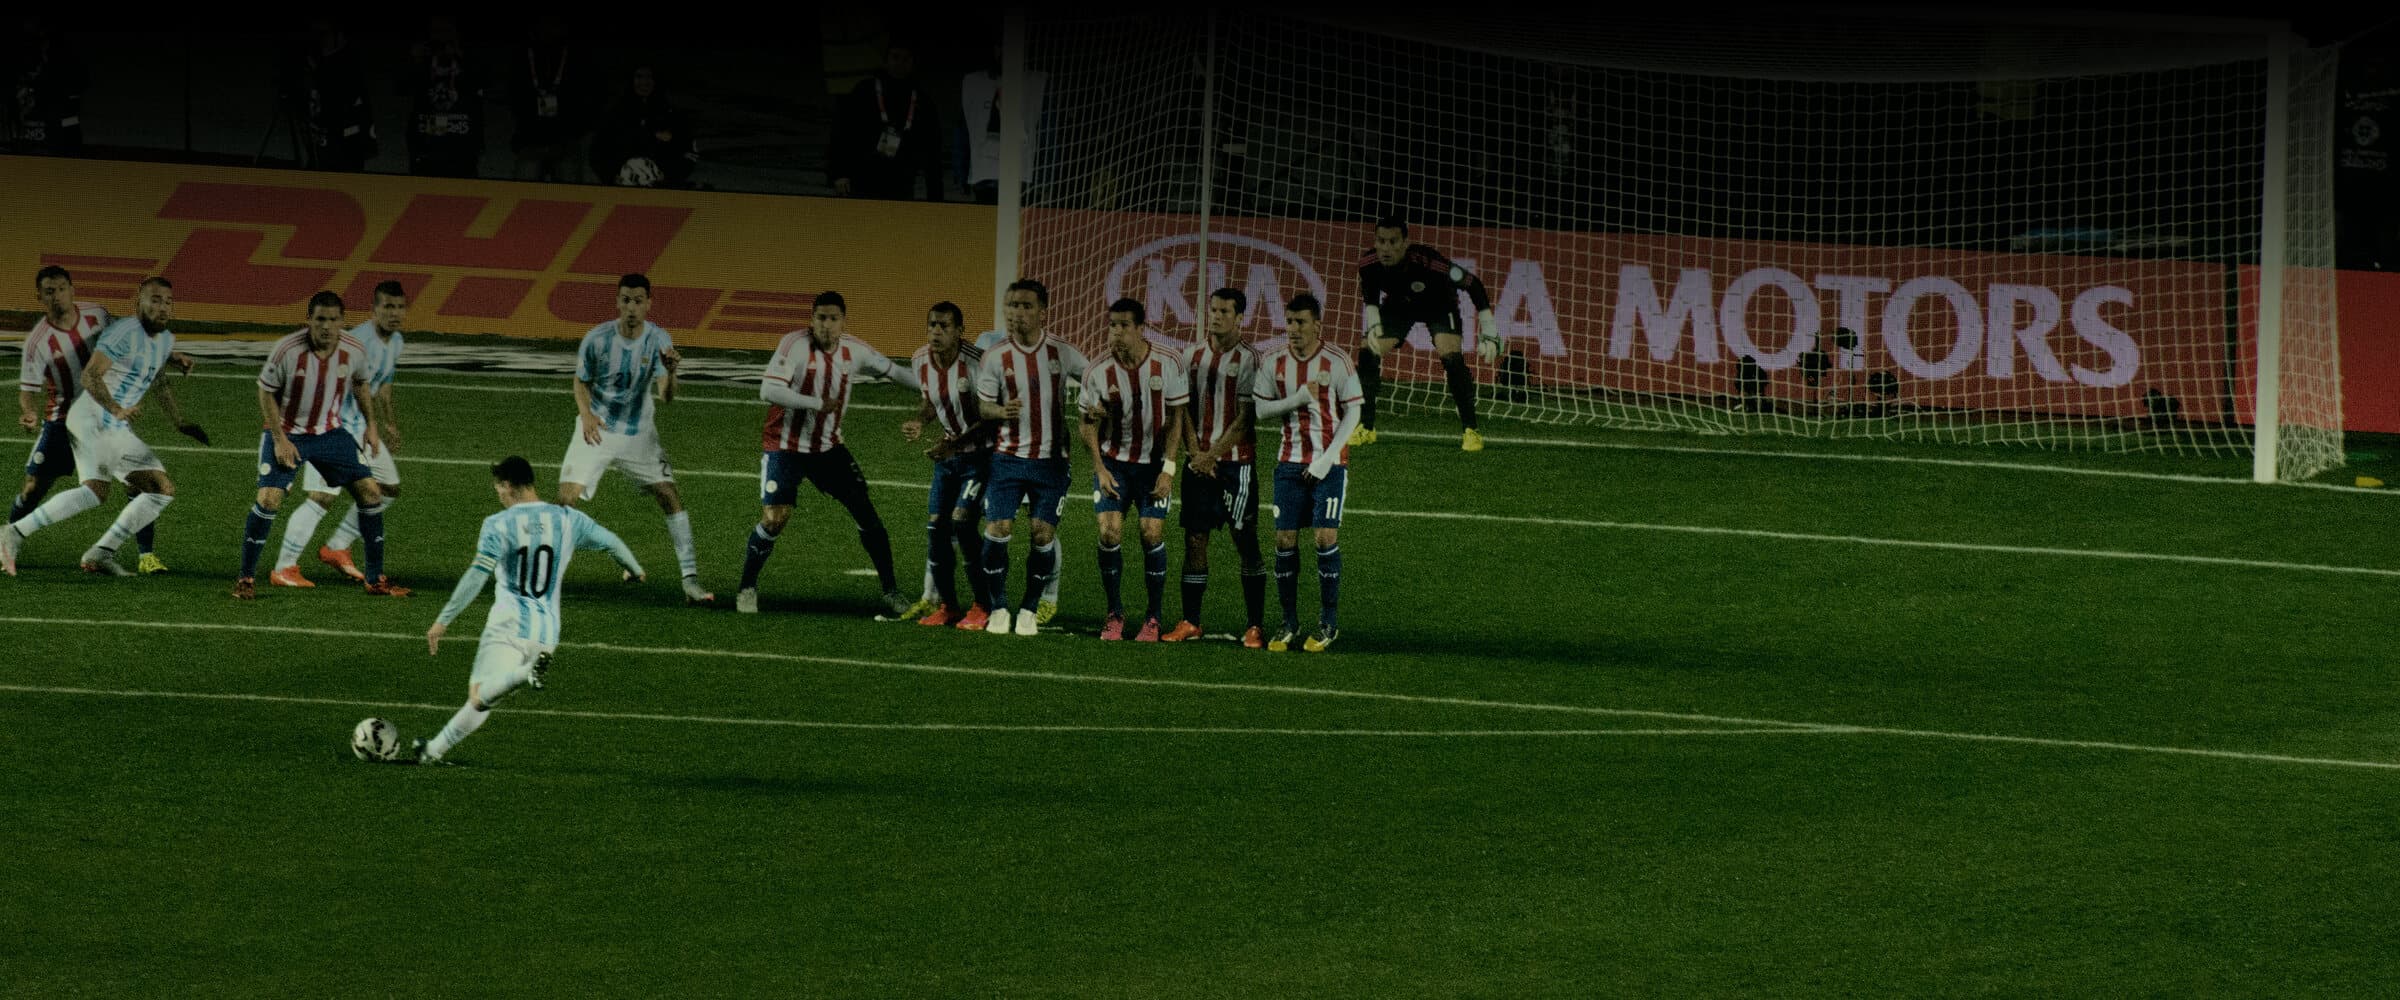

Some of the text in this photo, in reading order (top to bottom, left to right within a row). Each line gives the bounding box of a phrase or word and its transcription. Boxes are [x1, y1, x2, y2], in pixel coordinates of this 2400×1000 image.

[157, 181, 723, 329] DHL
[1448, 312, 1455, 330] 1
[1607, 263, 2141, 388] MOTORS
[614, 372, 632, 389] 21
[961, 478, 983, 502] 14
[1325, 496, 1339, 520] 11
[516, 544, 555, 599] 10
